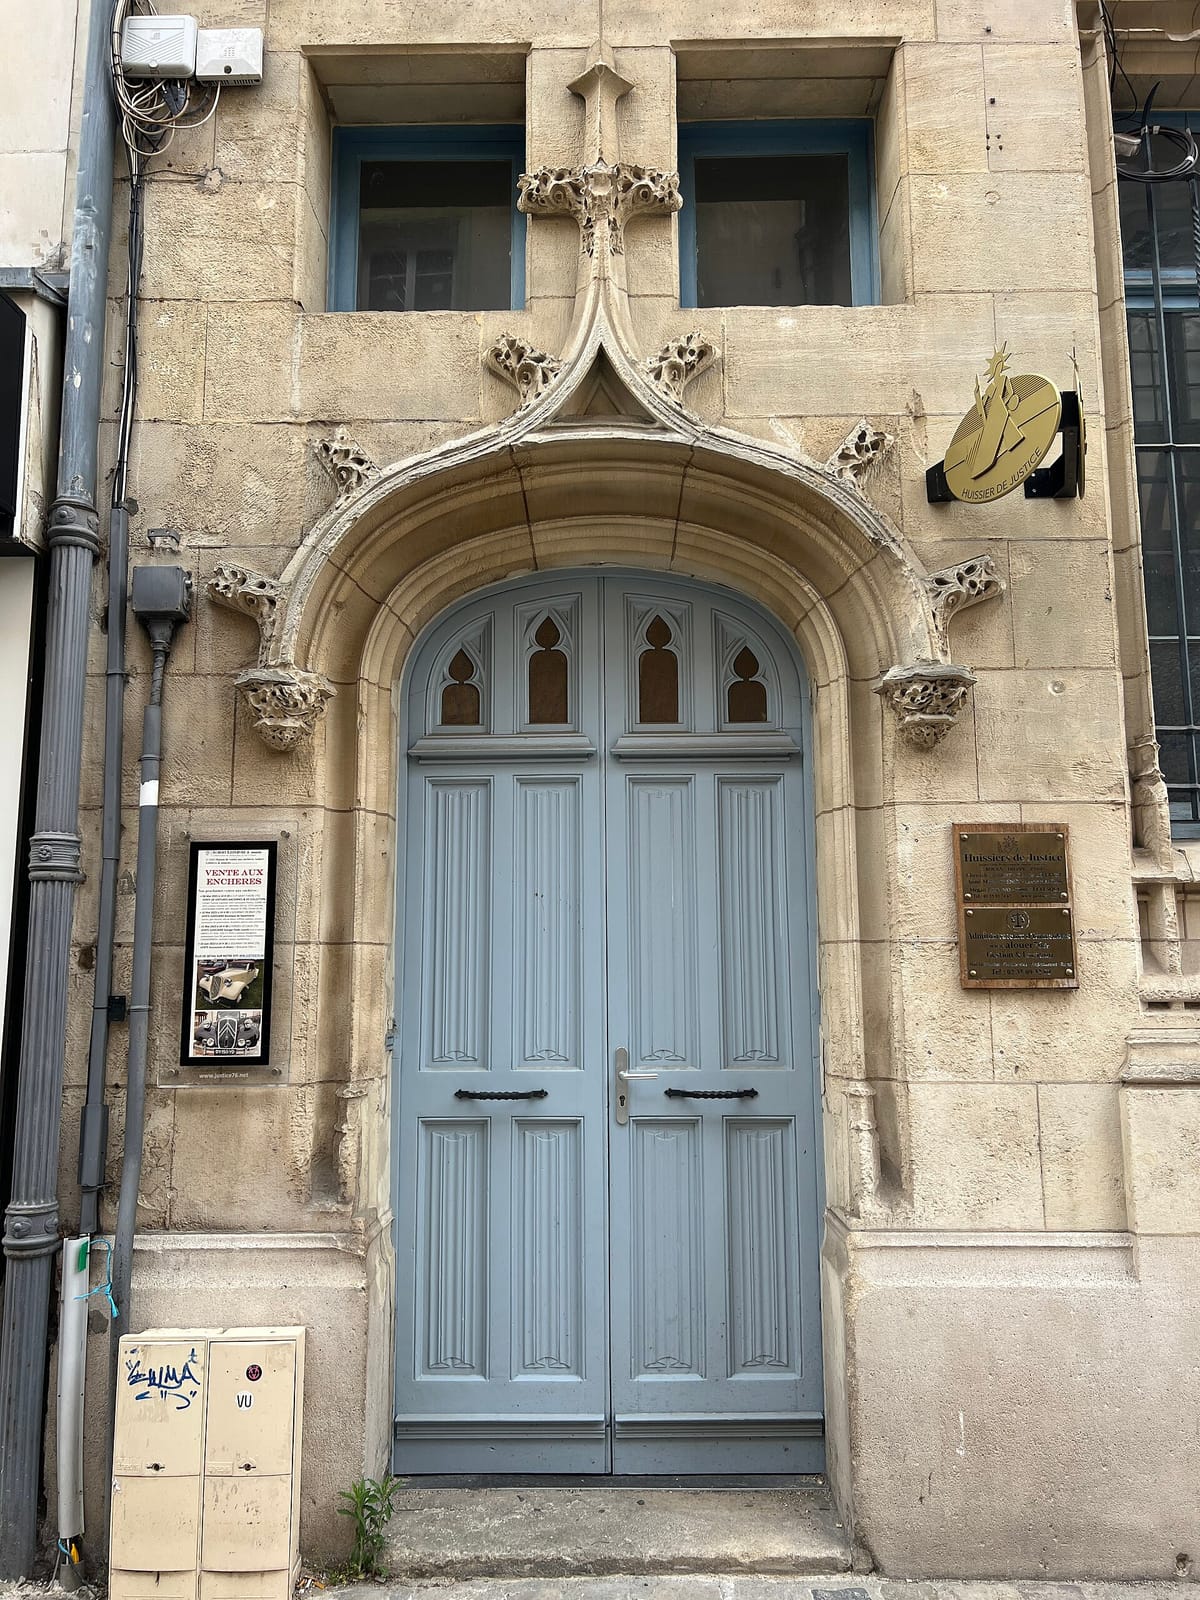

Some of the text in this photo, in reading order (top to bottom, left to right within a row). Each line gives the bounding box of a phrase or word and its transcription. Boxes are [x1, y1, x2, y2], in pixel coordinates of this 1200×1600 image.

[961, 446, 1042, 499] HUISSIER DE JUSTICE
[964, 853, 1063, 862] Huissiers de Justice
[205, 868, 264, 877] VENTE AUX
[206, 878, 262, 886] ENCHERES
[236, 1394, 252, 1408] VU
